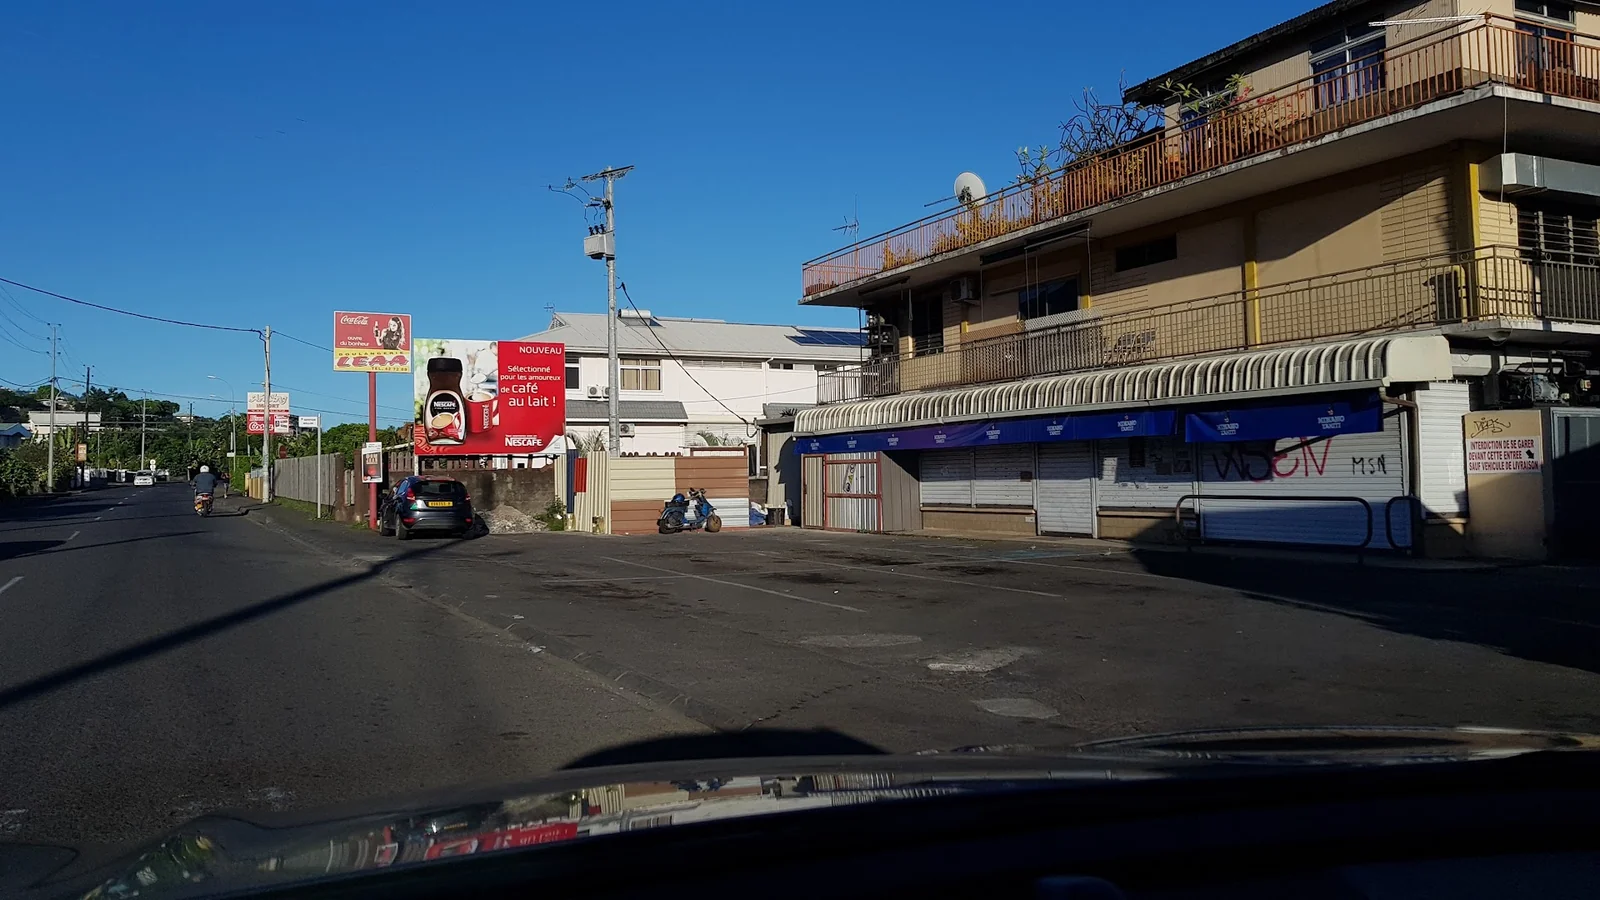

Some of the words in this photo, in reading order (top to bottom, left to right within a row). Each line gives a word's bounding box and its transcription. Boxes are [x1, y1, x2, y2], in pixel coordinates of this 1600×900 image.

[519, 346, 562, 355] NOUVEAU
[337, 355, 409, 367] LEAA
[507, 365, 551, 373] Sélectionné
[511, 382, 538, 394] café
[508, 397, 524, 407] au
[527, 395, 549, 407] lait
[552, 396, 556, 407] !
[1471, 440, 1502, 450] INTERDICTION
[1503, 440, 1510, 449] DE
[1511, 440, 1517, 449] SE
[1518, 439, 1534, 448] GARER
[1469, 452, 1486, 460] DEVANT
[1488, 451, 1502, 460] CETTE
[1504, 450, 1522, 459] ENTREE
[1352, 454, 1387, 474] MSN
[1469, 462, 1481, 470] SAUF
[1482, 461, 1504, 470] VEHICULE
[1506, 461, 1512, 470] DE
[1513, 461, 1539, 470] LIVRAISON
